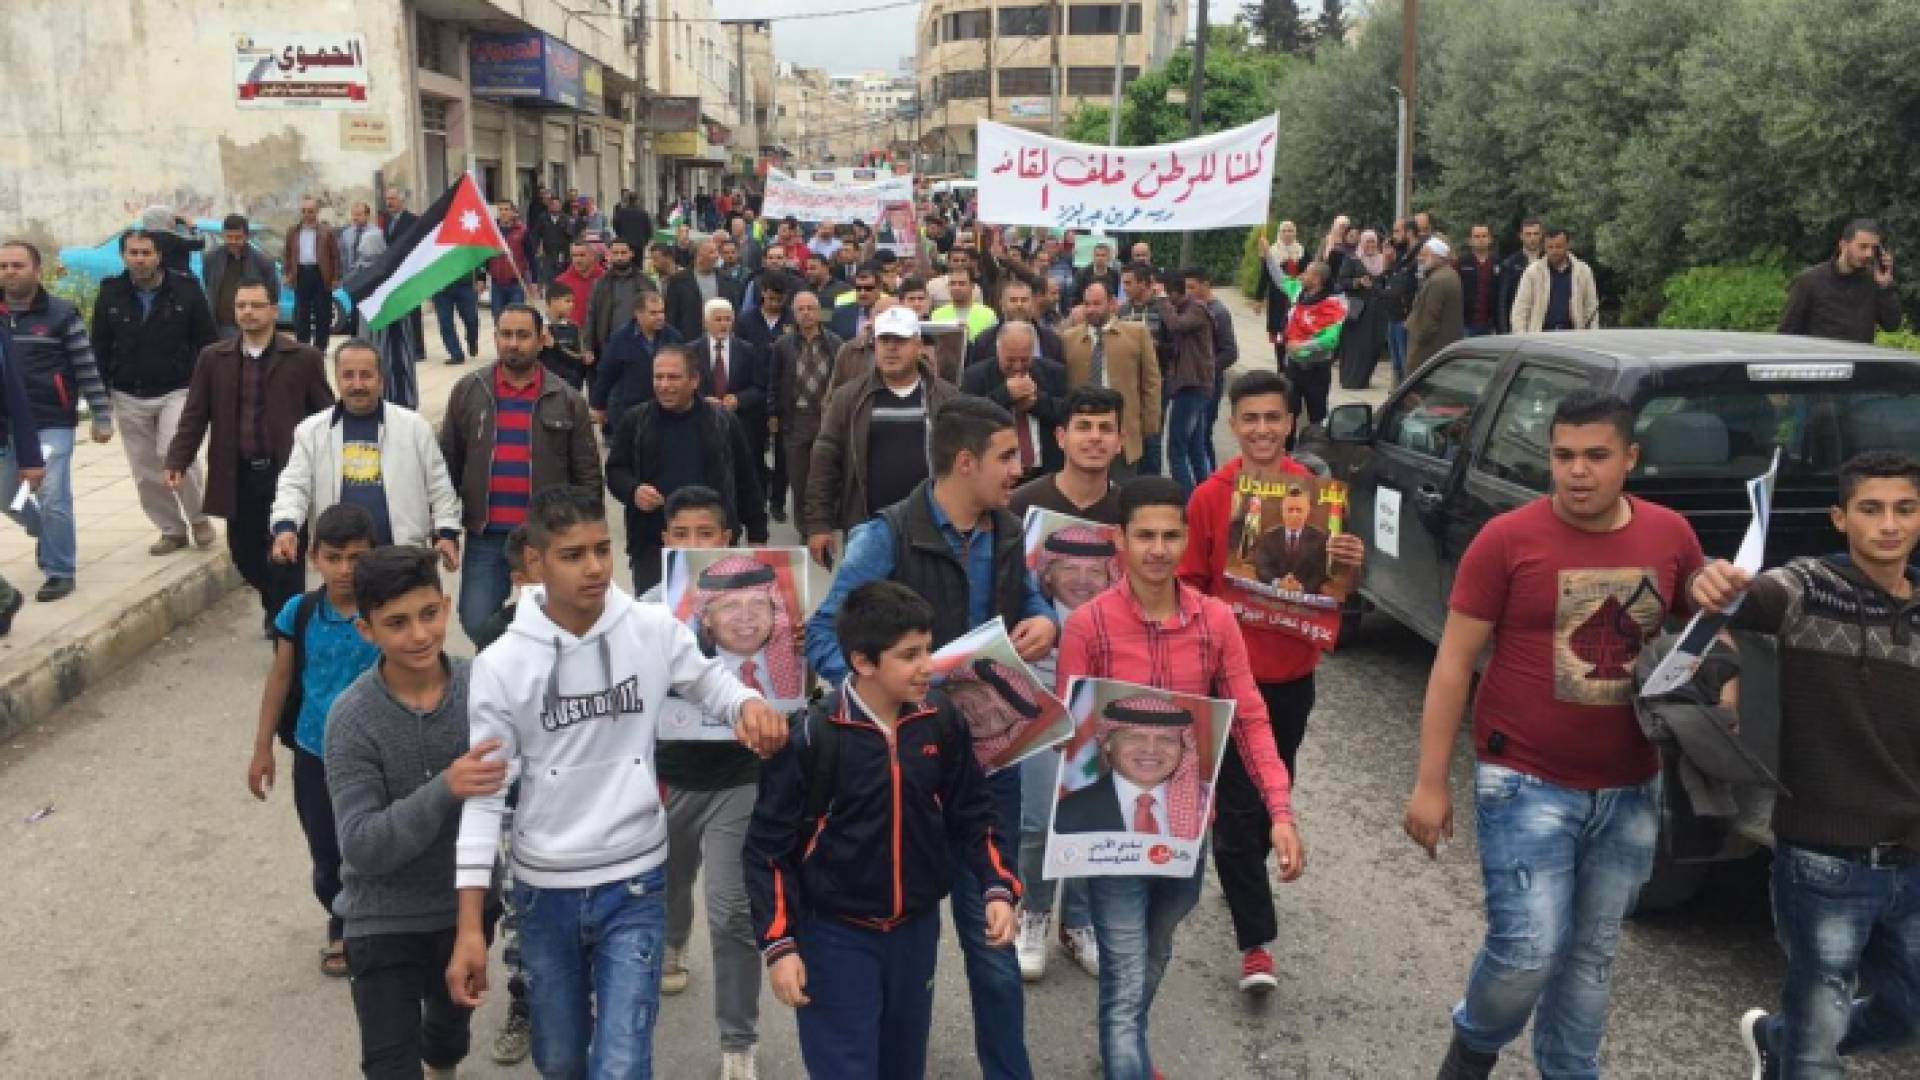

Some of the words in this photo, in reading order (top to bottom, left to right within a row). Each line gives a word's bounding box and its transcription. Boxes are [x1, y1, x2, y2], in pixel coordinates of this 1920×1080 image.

[278, 38, 362, 79] الحموي
[1052, 152, 1127, 187] خلف
[1131, 150, 1217, 204] للوطن
[1225, 130, 1275, 185] كلنا
